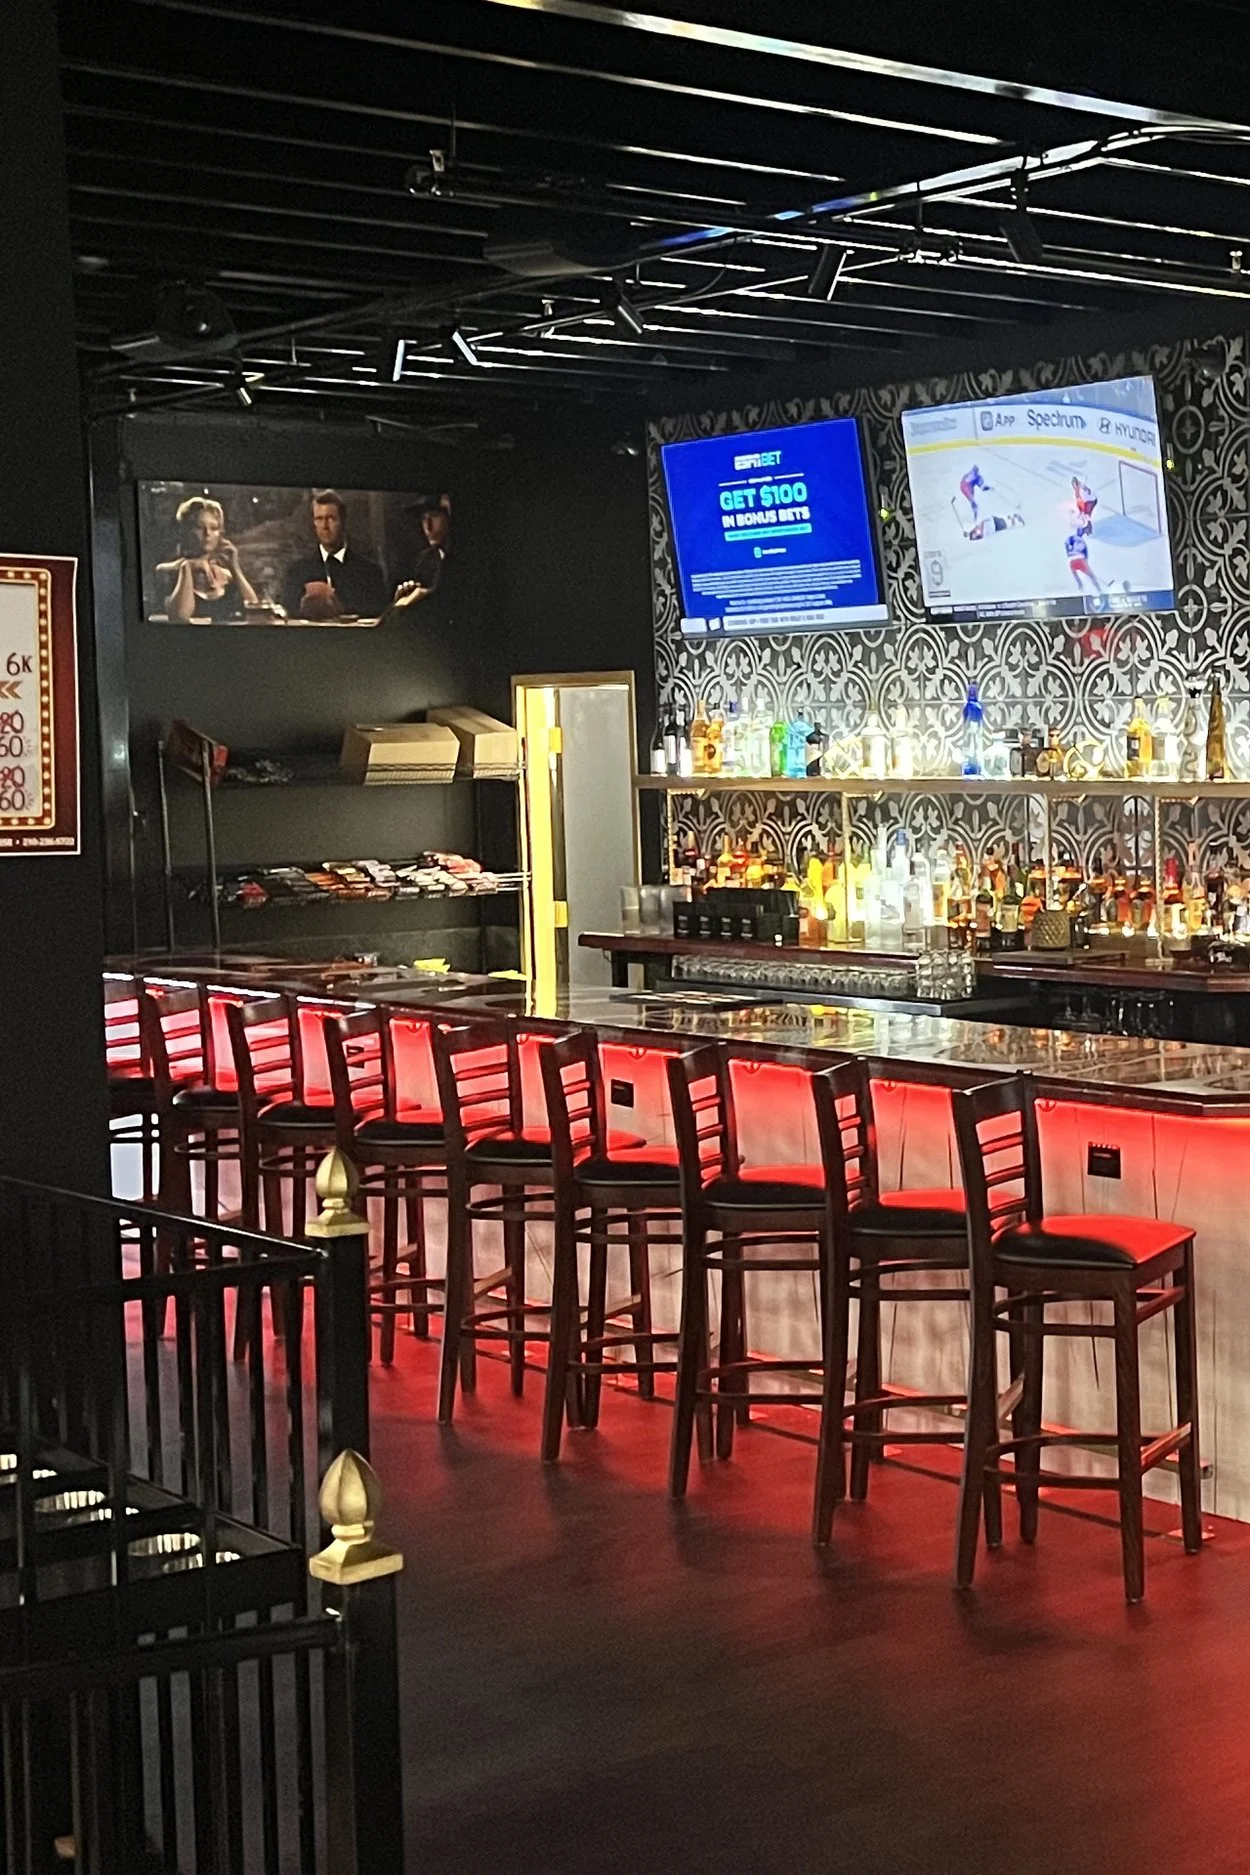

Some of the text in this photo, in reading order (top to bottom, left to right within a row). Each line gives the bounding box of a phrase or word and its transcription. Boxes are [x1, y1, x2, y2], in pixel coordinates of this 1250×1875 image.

[1027, 409, 1084, 431] Spectrum
[720, 482, 807, 510] GET $100
[722, 506, 811, 528] IN BONUS BETS
